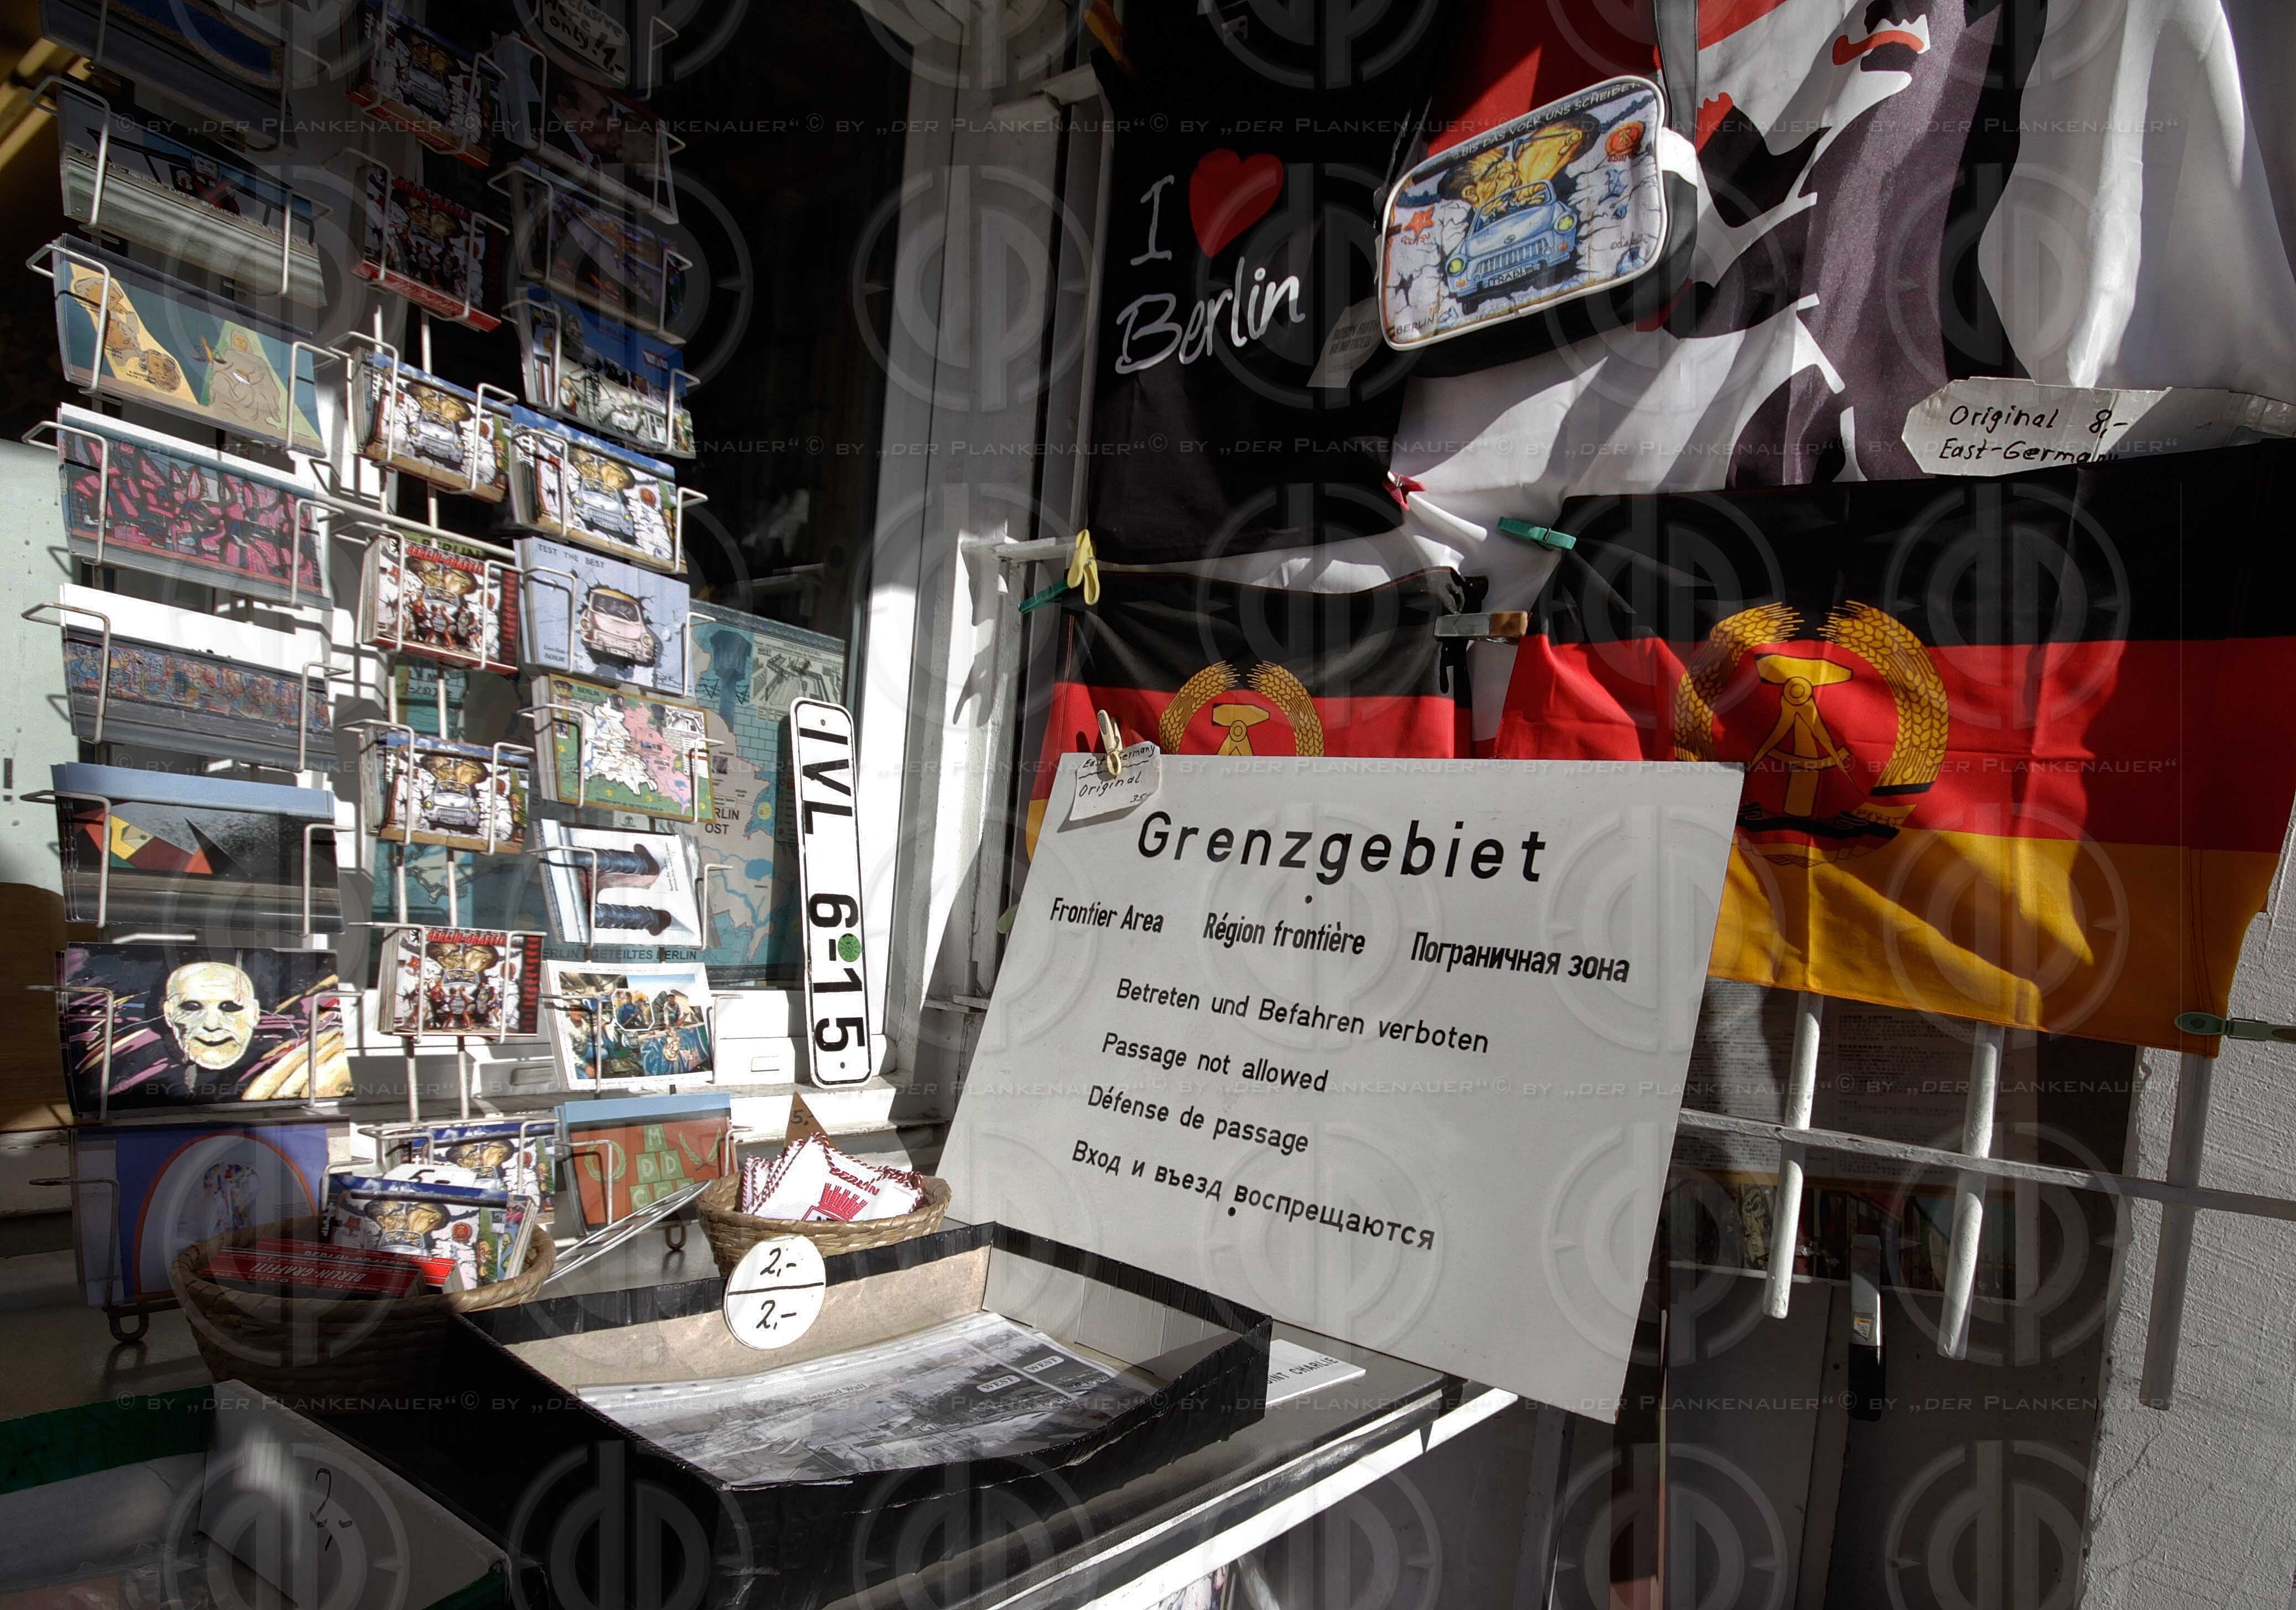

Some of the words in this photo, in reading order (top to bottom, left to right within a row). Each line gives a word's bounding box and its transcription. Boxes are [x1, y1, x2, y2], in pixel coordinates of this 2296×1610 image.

[1546, 104, 1572, 120] UNS
[1130, 175, 1175, 266] I
[1115, 256, 1306, 374] Berlin
[1396, 315, 1436, 335] BERLIN
[1950, 405, 2059, 434] Original
[538, 543, 558, 555] TEST
[564, 552, 579, 562] THE
[585, 556, 605, 568] BEST
[799, 728, 853, 834] IVL
[1078, 770, 1140, 797] Original
[705, 823, 729, 835] OST
[1137, 811, 1546, 885] Grenzgebiet
[1050, 897, 1118, 928] Frontier
[1121, 904, 1164, 933] Area
[1203, 911, 1266, 949] Région
[1272, 920, 1366, 955] frontière
[591, 949, 653, 960] GETEILTES
[1410, 931, 1561, 978] Пограничная
[1567, 952, 1630, 984] зона
[1116, 978, 1201, 1011] Betreten
[1210, 995, 1250, 1017] und
[1258, 997, 1365, 1036] Befahren
[1377, 1018, 1490, 1054] verboten
[1102, 1032, 1188, 1070] Passage
[1196, 1051, 1231, 1075] not
[1241, 1058, 1330, 1092] allowed
[1087, 1085, 1170, 1122] Défense
[1179, 1104, 1205, 1130] de
[1212, 1116, 1309, 1156] passage
[648, 1127, 663, 1146] M
[1071, 1139, 1121, 1176] Вход
[1130, 1158, 1146, 1178] и
[1154, 1164, 1223, 1201] въезд
[1233, 1183, 1436, 1251] воспрещаются
[251, 1262, 367, 1284] BERLIN-GRAFFITI
[759, 1247, 797, 1278] 2,-
[755, 1299, 797, 1330] 2,-
[1027, 1356, 1059, 1372] WEST
[1288, 1357, 1339, 1376] CHARLIE
[803, 1388, 842, 1402] Second
[844, 1383, 870, 1395] Wall
[980, 1376, 1015, 1391] WEST
